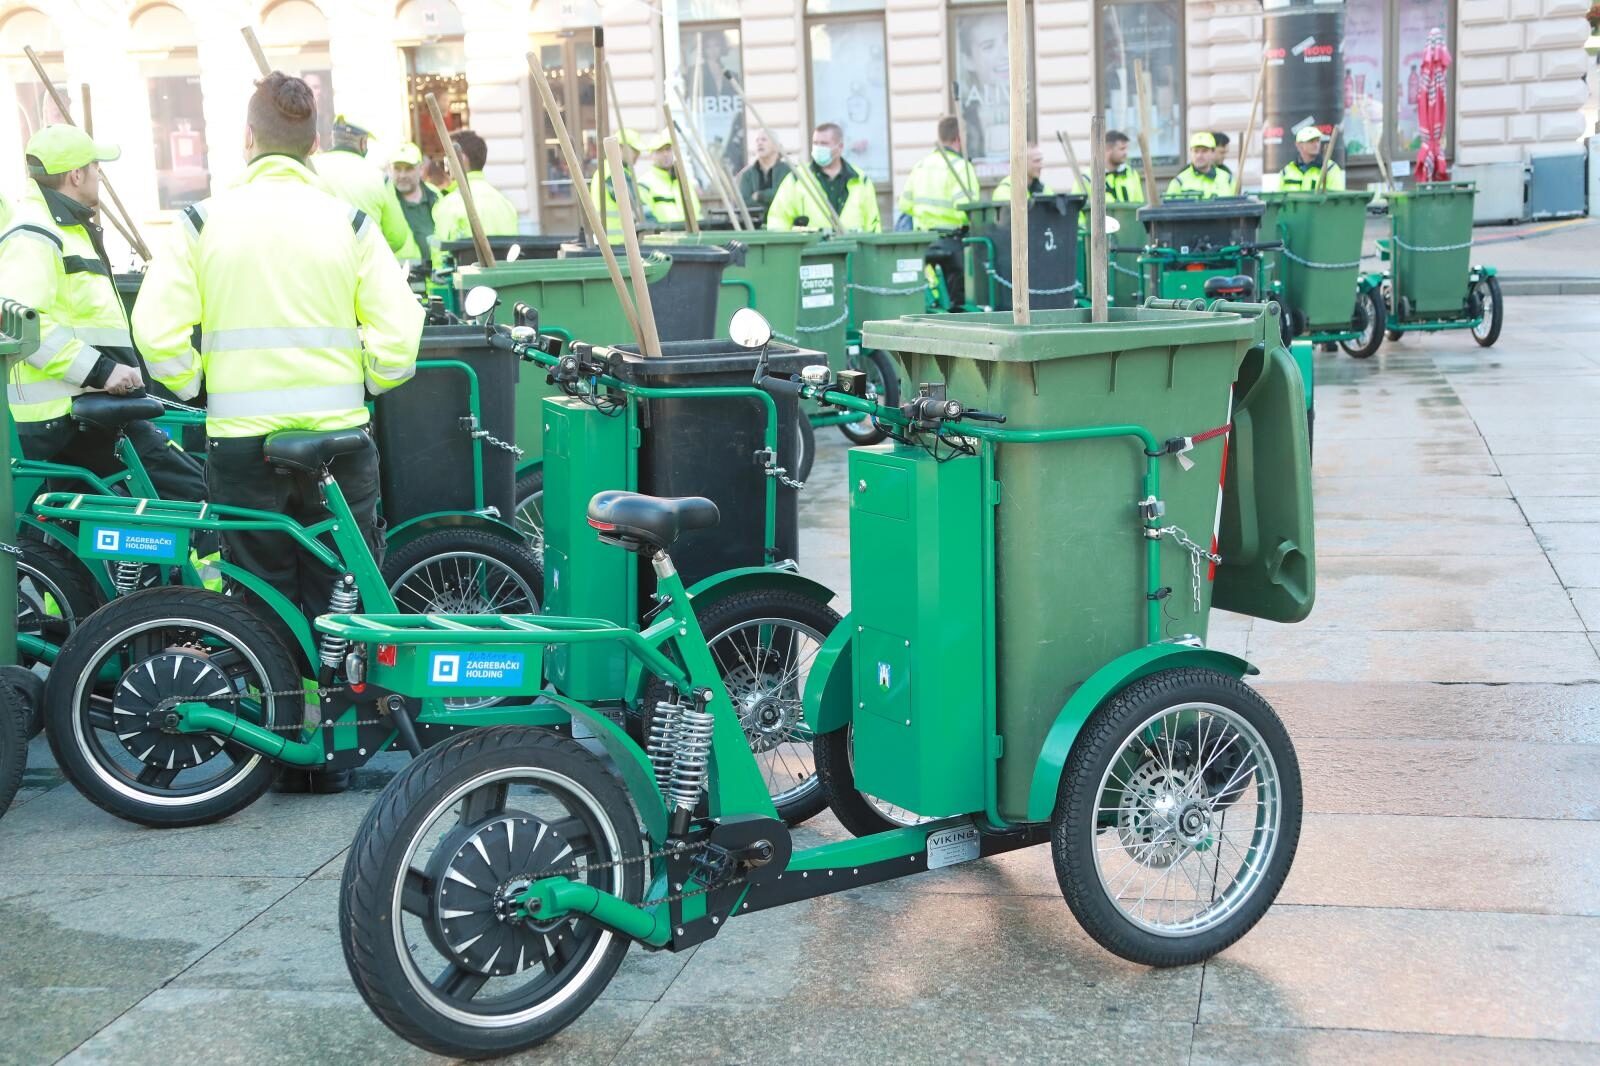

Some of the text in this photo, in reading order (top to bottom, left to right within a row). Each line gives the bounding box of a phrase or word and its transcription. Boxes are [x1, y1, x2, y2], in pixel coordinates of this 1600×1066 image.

[125, 536, 172, 546] ZAGREBAČKI
[125, 543, 158, 551] HOLDING
[466, 660, 519, 669] ZAGREBAČKI
[466, 670, 503, 678] HOLDING
[933, 830, 975, 846] VIKING
